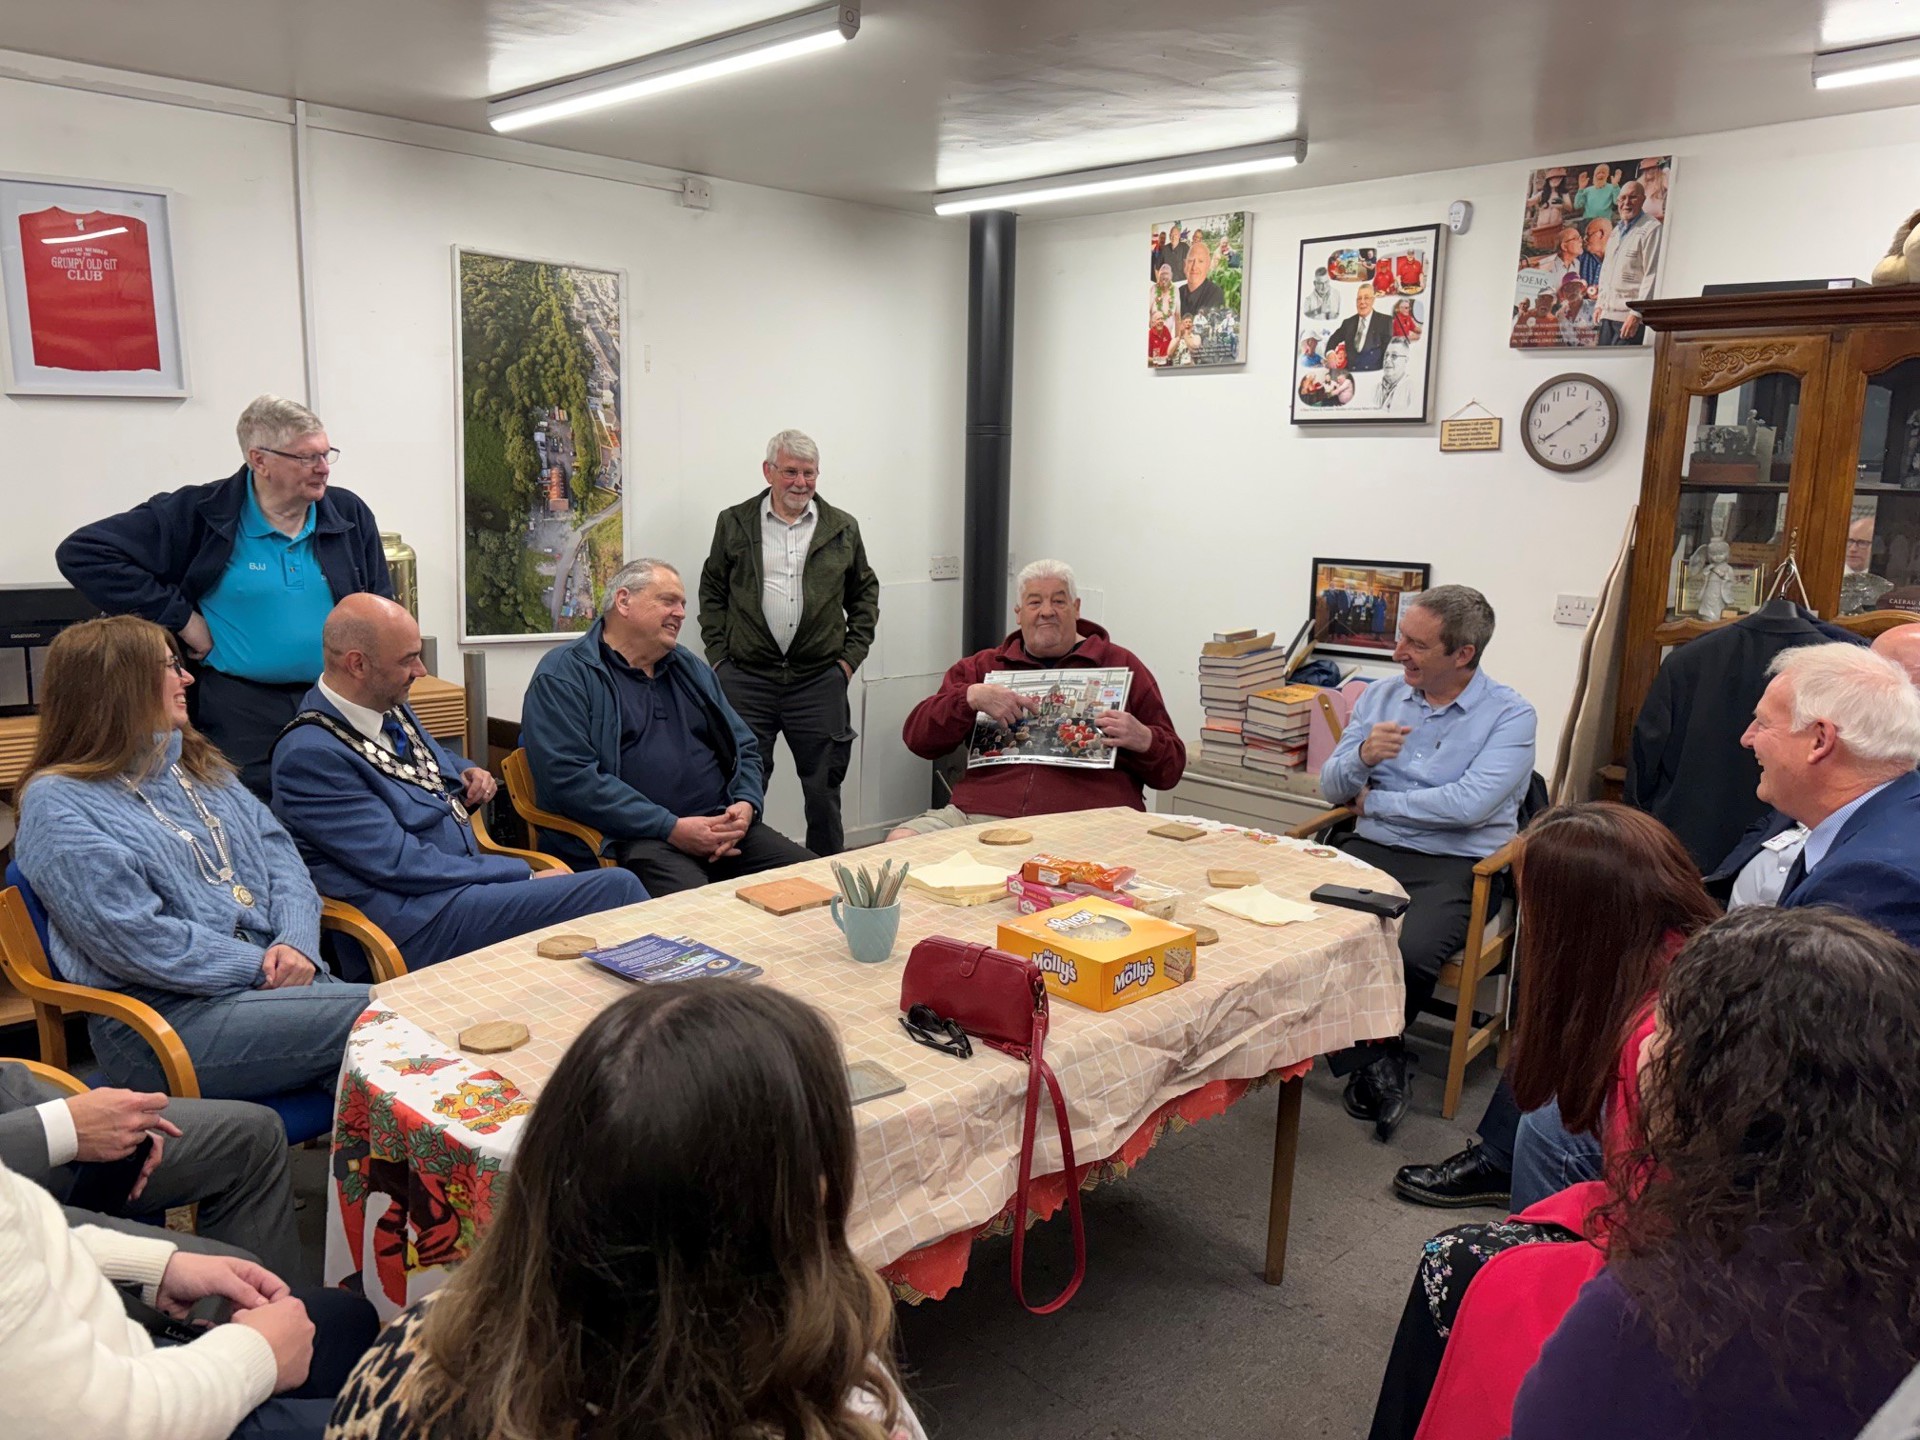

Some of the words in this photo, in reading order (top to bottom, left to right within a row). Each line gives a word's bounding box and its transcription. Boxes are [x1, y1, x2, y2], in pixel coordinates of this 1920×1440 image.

[51, 256, 85, 270] GRUMPY
[86, 258, 102, 270] OLD
[103, 258, 118, 270] GIT
[67, 270, 103, 281] CLUB
[1517, 274, 1548, 286] POEMS
[1552, 391, 1560, 402] 11
[1567, 386, 1577, 397] 12
[1585, 389, 1589, 400] 1
[1540, 403, 1550, 414] 10
[1595, 400, 1602, 412] 2
[1534, 418, 1542, 429] 9
[1597, 416, 1606, 427] 3
[1537, 434, 1546, 445] 8
[1591, 432, 1598, 444] 4
[1549, 444, 1557, 456] 7
[1563, 449, 1571, 460] 6
[1579, 444, 1588, 455] 5
[249, 562, 266, 571] BJJ
[1032, 952, 1077, 985] Molly's
[1113, 956, 1155, 995] Molly's
